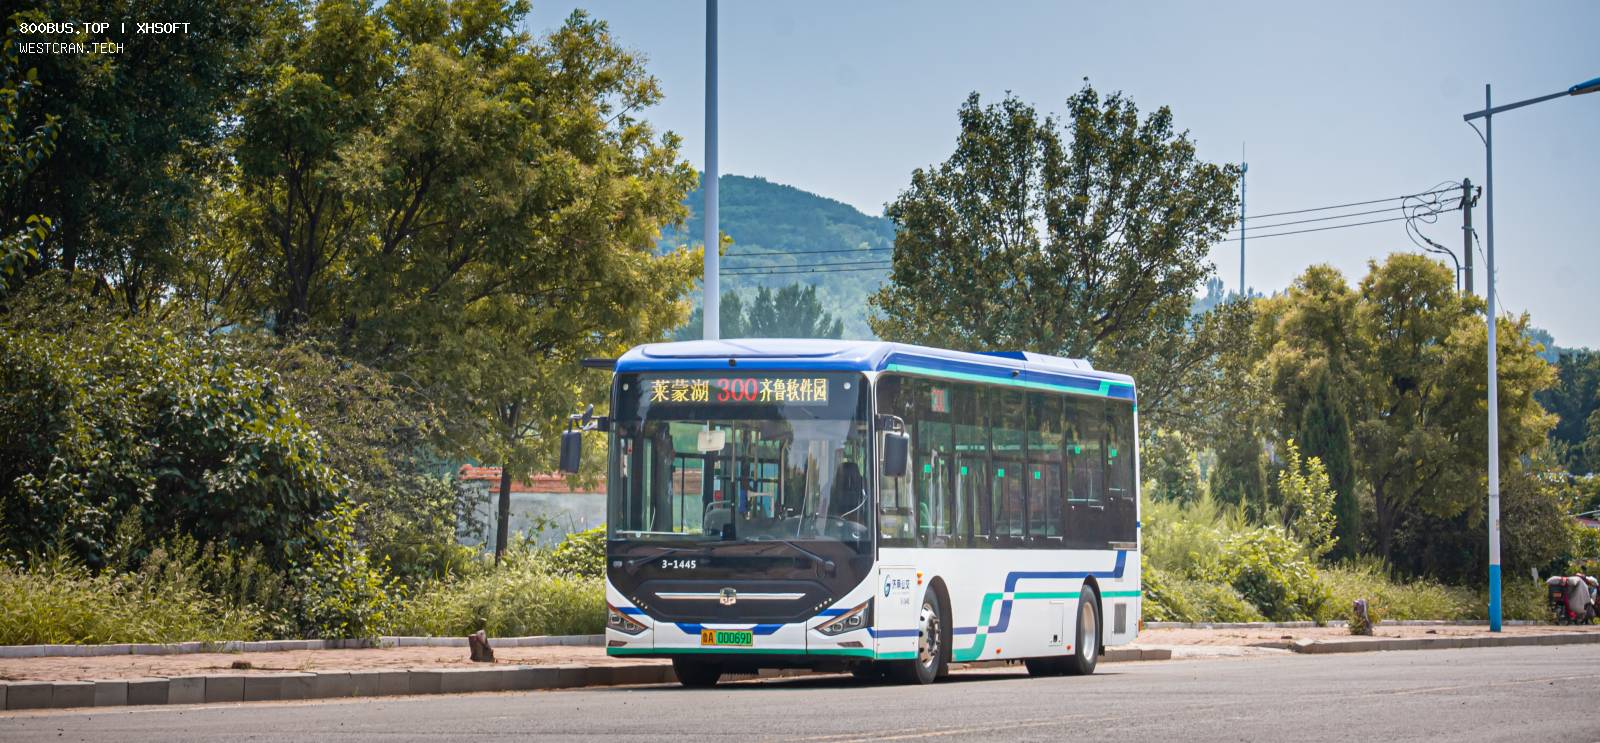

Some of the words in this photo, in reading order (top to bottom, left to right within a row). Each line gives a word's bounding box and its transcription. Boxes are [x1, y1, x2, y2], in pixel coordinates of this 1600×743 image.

[650, 379, 709, 402] 莱蒙湖
[717, 378, 758, 402] 300
[760, 378, 827, 402] 齐鲁软件园
[661, 559, 697, 569] 3-1445
